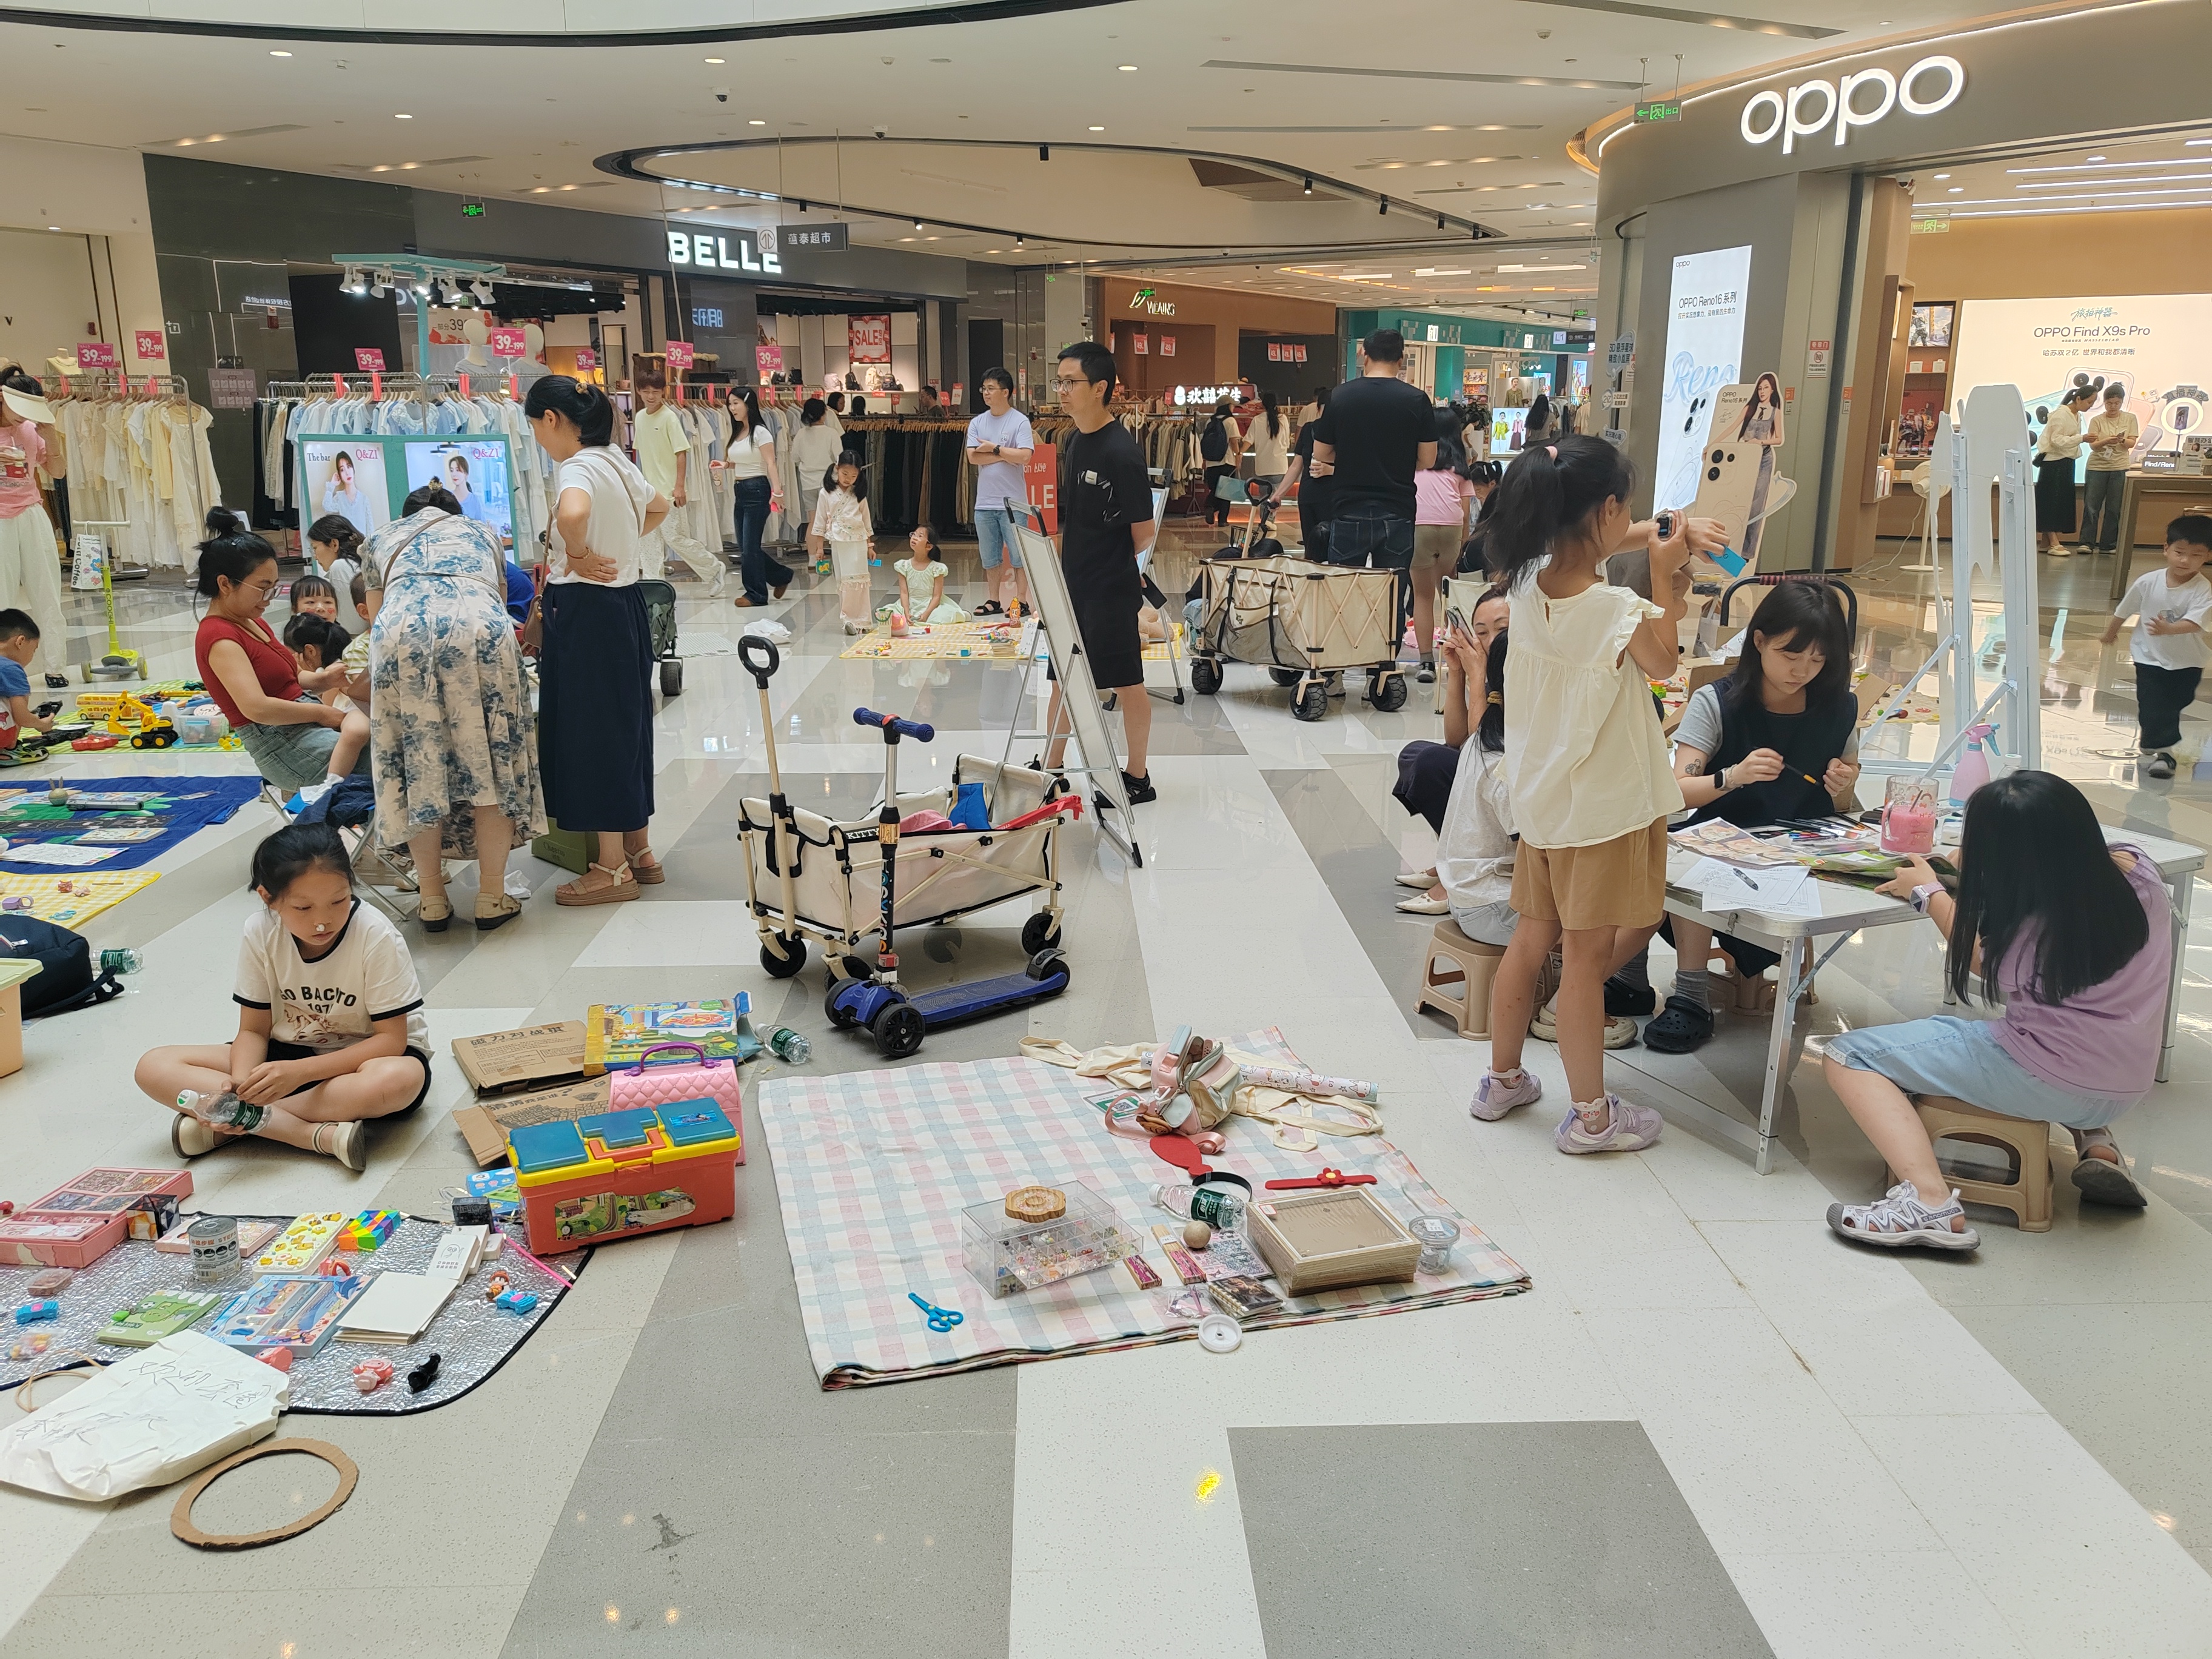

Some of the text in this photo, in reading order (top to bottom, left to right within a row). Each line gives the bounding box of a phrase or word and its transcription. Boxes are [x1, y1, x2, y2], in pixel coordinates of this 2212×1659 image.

[1740, 55, 1966, 155] oppo
[667, 232, 782, 273] BELLE
[1678, 291, 1737, 309] OPPO Reno16 系列
[855, 329, 879, 346] SALE
[2034, 325, 2151, 338] OPPO Find X9s Pro
[307, 453, 330, 461] The bar
[355, 449, 378, 460] Q&ZI
[473, 448, 500, 460] Q&ZI
[1031, 484, 1054, 509] LE
[72, 558, 82, 586] Coffee
[846, 828, 880, 840] KITTY
[301, 986, 339, 1001] BAC
[218, 1232, 236, 1242] STEPS
